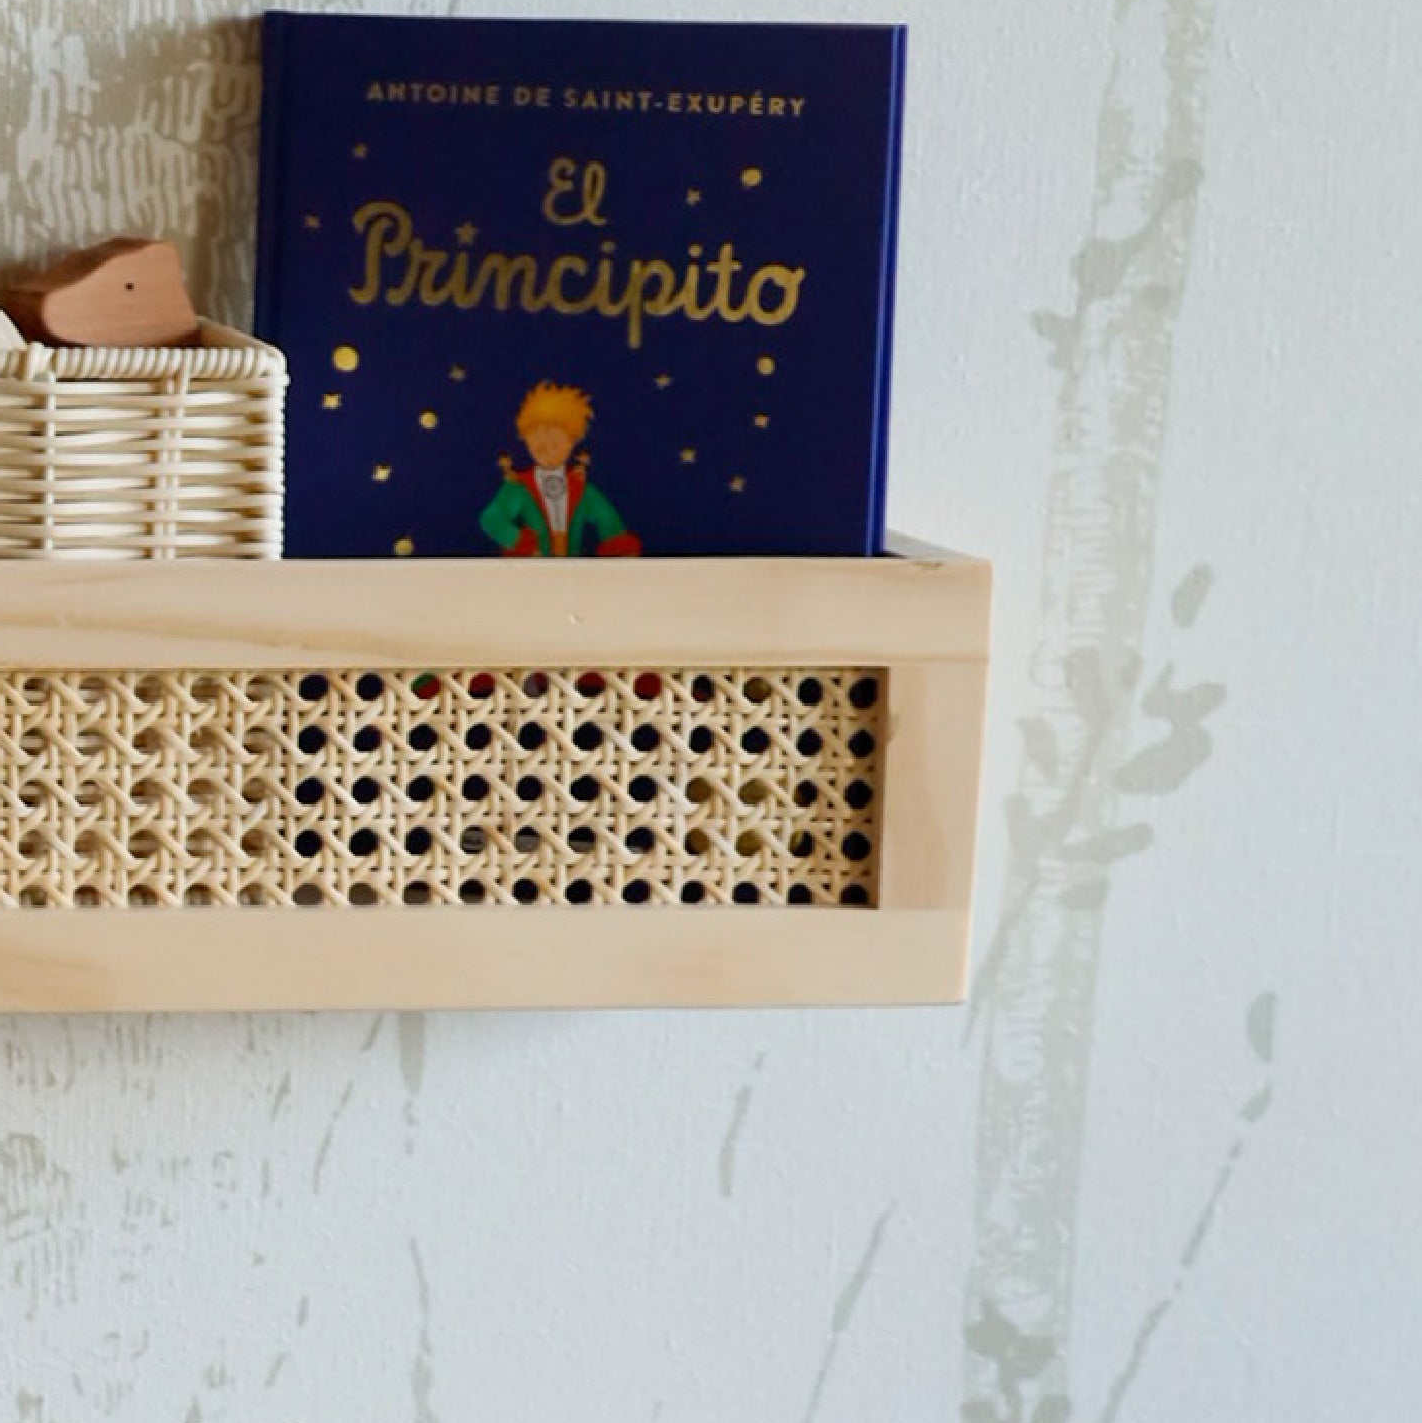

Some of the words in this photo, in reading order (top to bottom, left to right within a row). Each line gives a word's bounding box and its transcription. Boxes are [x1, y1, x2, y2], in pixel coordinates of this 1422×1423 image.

[365, 81, 500, 107] ANTOINE
[513, 86, 551, 108] DE
[563, 88, 806, 118] SAINT-EXUPÉRY
[542, 156, 608, 226] El
[348, 200, 806, 350] Principito
